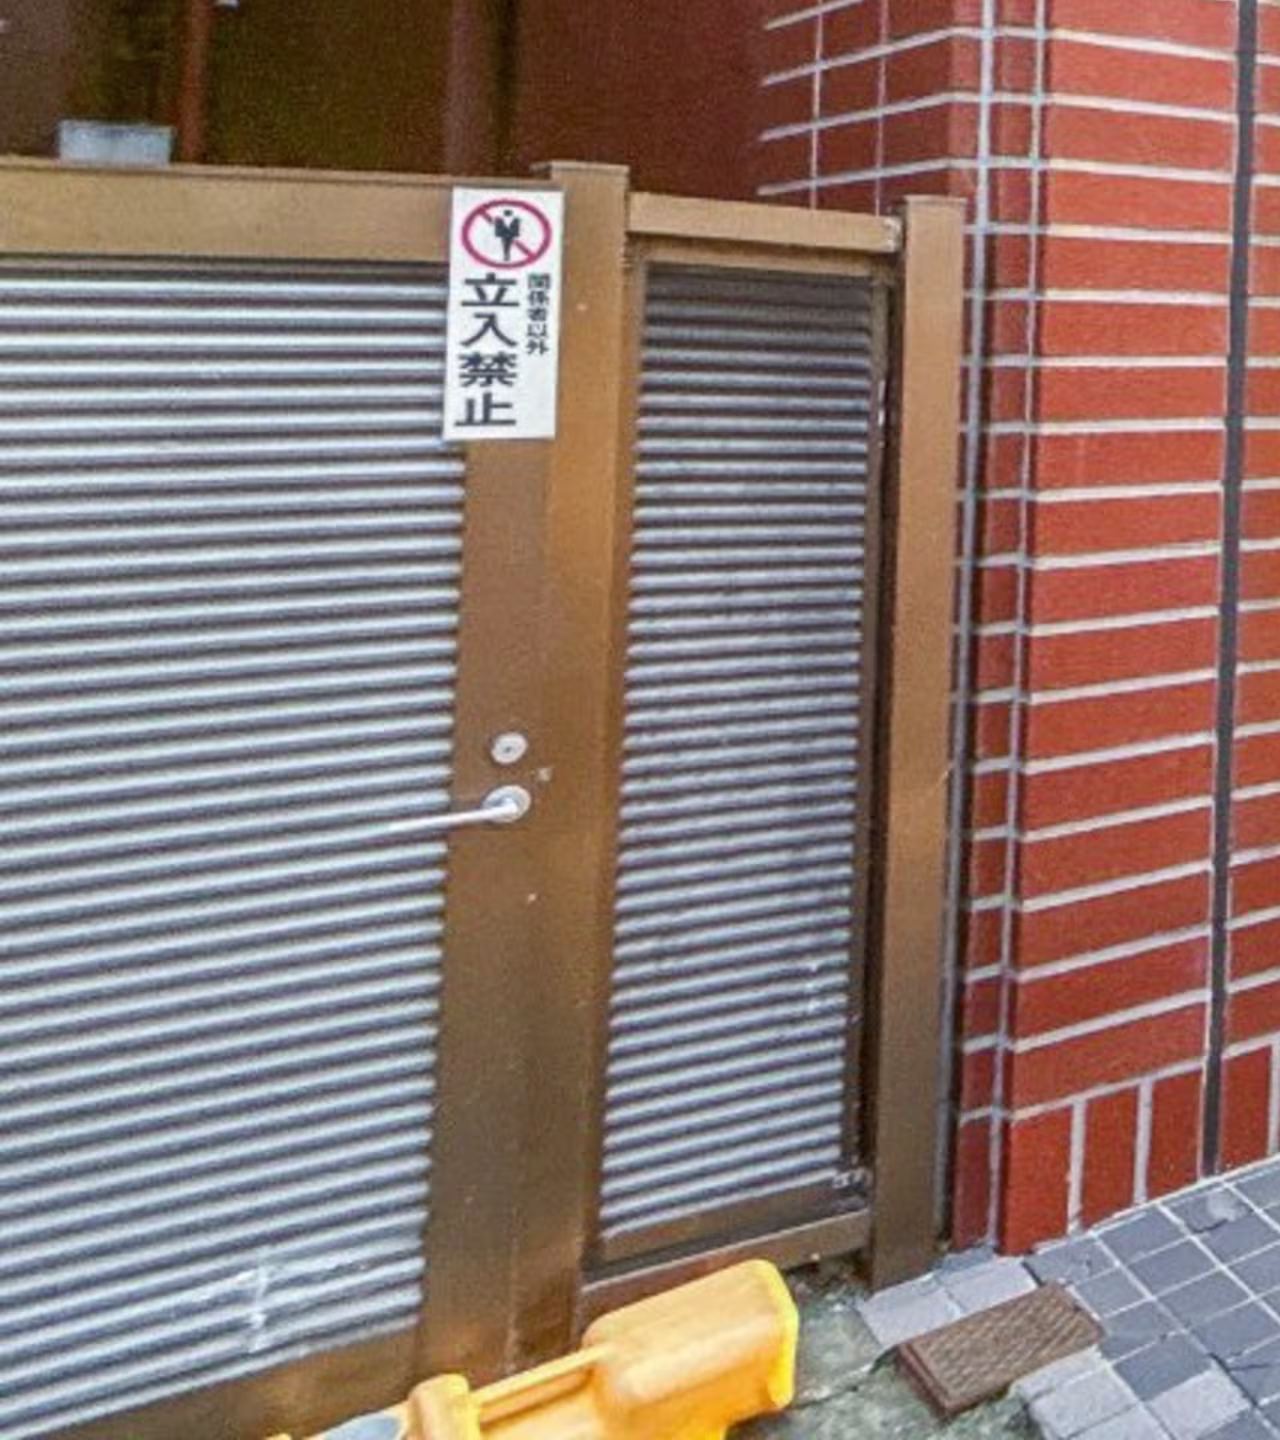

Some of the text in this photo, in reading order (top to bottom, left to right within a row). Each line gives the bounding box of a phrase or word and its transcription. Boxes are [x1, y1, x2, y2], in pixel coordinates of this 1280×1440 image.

[454, 273, 520, 427] 立入禁止
[526, 273, 551, 355] 関係者以外
